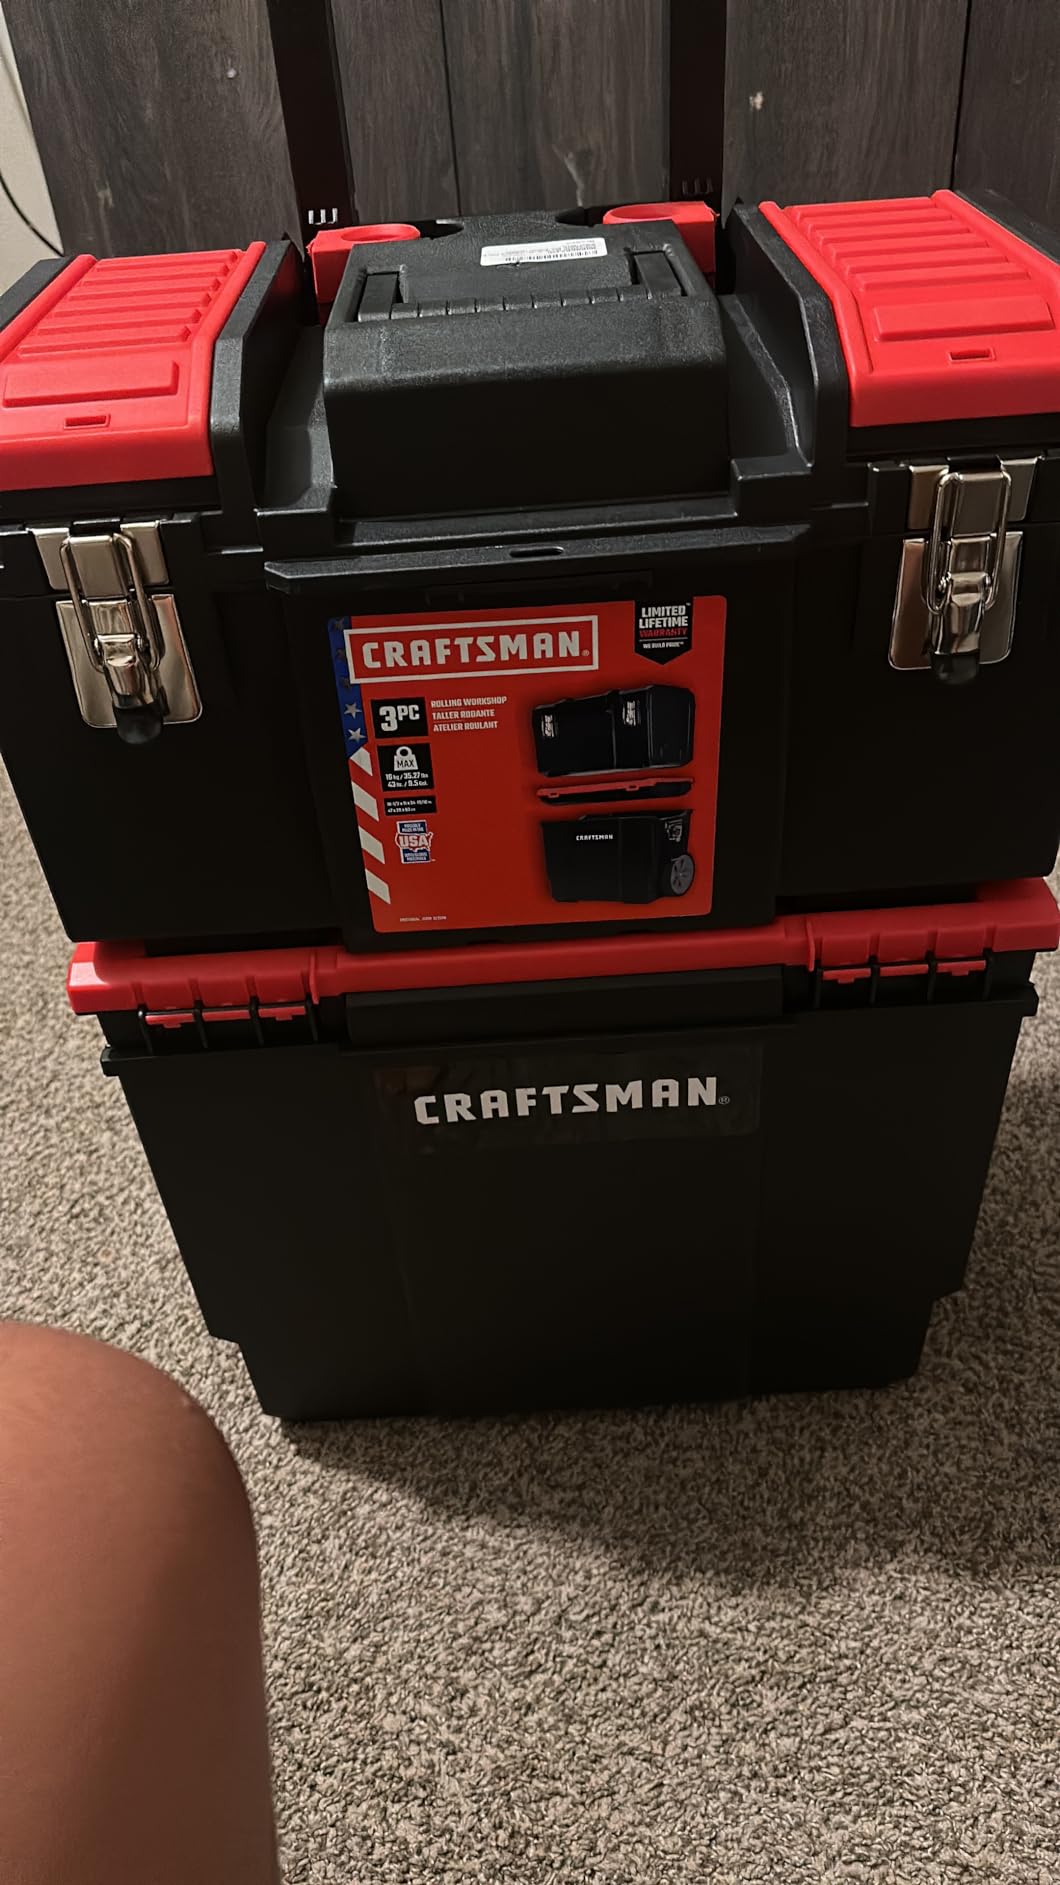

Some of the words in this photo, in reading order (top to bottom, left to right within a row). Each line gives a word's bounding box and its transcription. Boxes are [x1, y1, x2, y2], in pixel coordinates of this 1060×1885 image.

[641, 605, 686, 618] LIMITED
[639, 616, 689, 629] LIFETIME
[639, 628, 688, 638] WARRANTY
[431, 699, 462, 709] ROLLING
[463, 696, 507, 706] WORKSHOP
[432, 711, 459, 721] TALLER
[460, 709, 495, 719] RODANTE
[433, 722, 463, 732] ATELIER
[464, 720, 499, 730] ROULANT
[397, 760, 415, 768] MAX
[398, 835, 429, 847] USA
